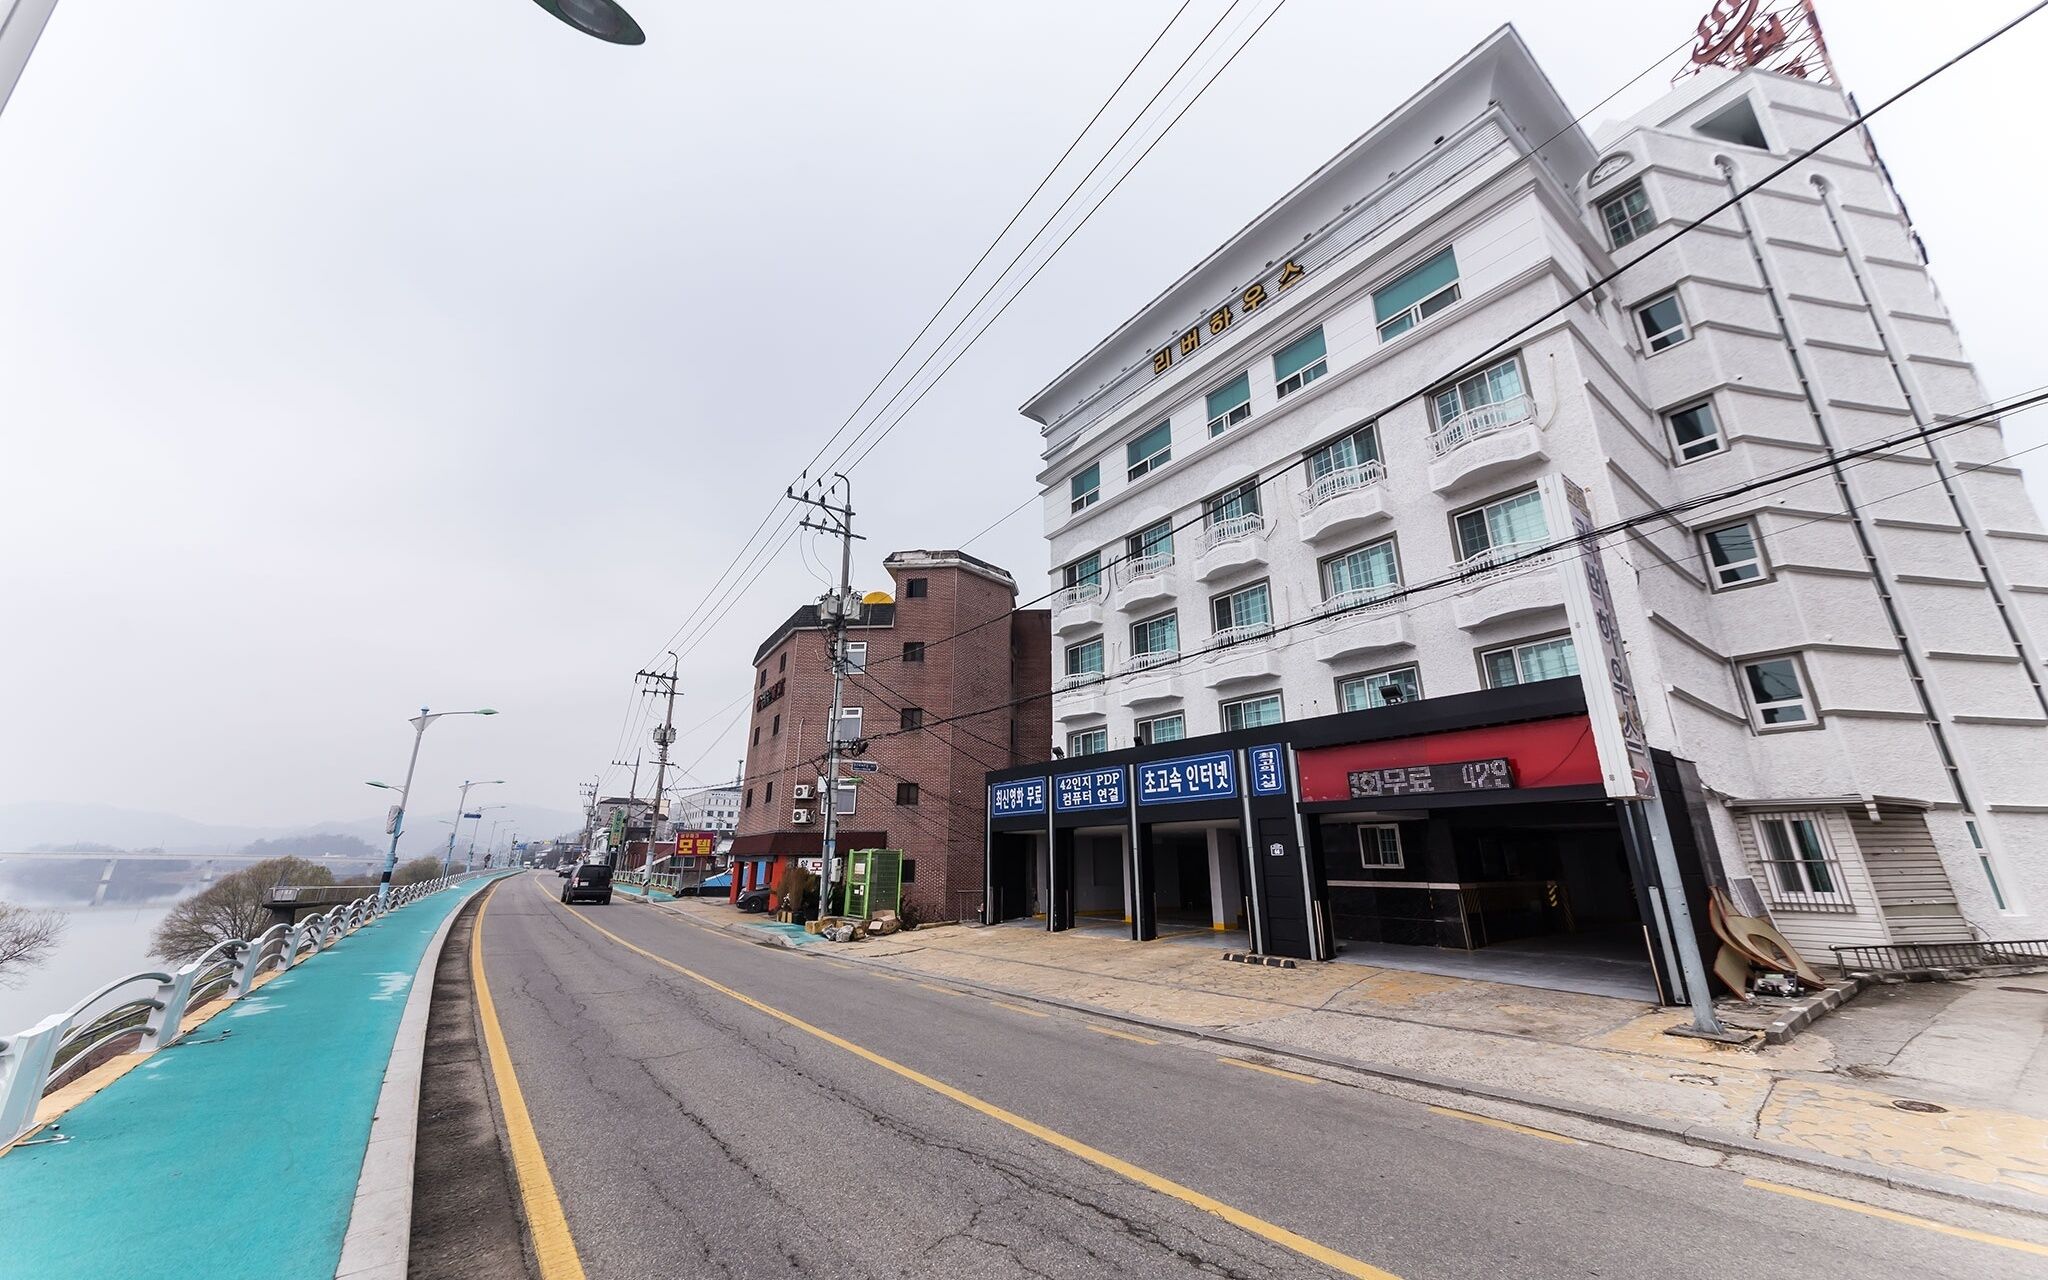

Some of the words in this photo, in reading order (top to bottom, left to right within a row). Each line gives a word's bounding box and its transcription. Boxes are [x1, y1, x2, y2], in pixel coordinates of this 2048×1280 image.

[1152, 259, 1306, 375] 리버하우스
[1574, 516, 1644, 755] 리버하우스
[1258, 751, 1275, 773] 최고의
[1096, 772, 1120, 787] PDP
[1144, 766, 1183, 794] 초고속
[1186, 760, 1229, 791] 인터넷
[1260, 773, 1277, 789] 시설
[995, 786, 1024, 810] 최신영화
[1027, 785, 1042, 807] 무료
[1062, 790, 1092, 806] 컴퓨터
[1097, 786, 1119, 803] 연결
[677, 839, 711, 855] 모텔
